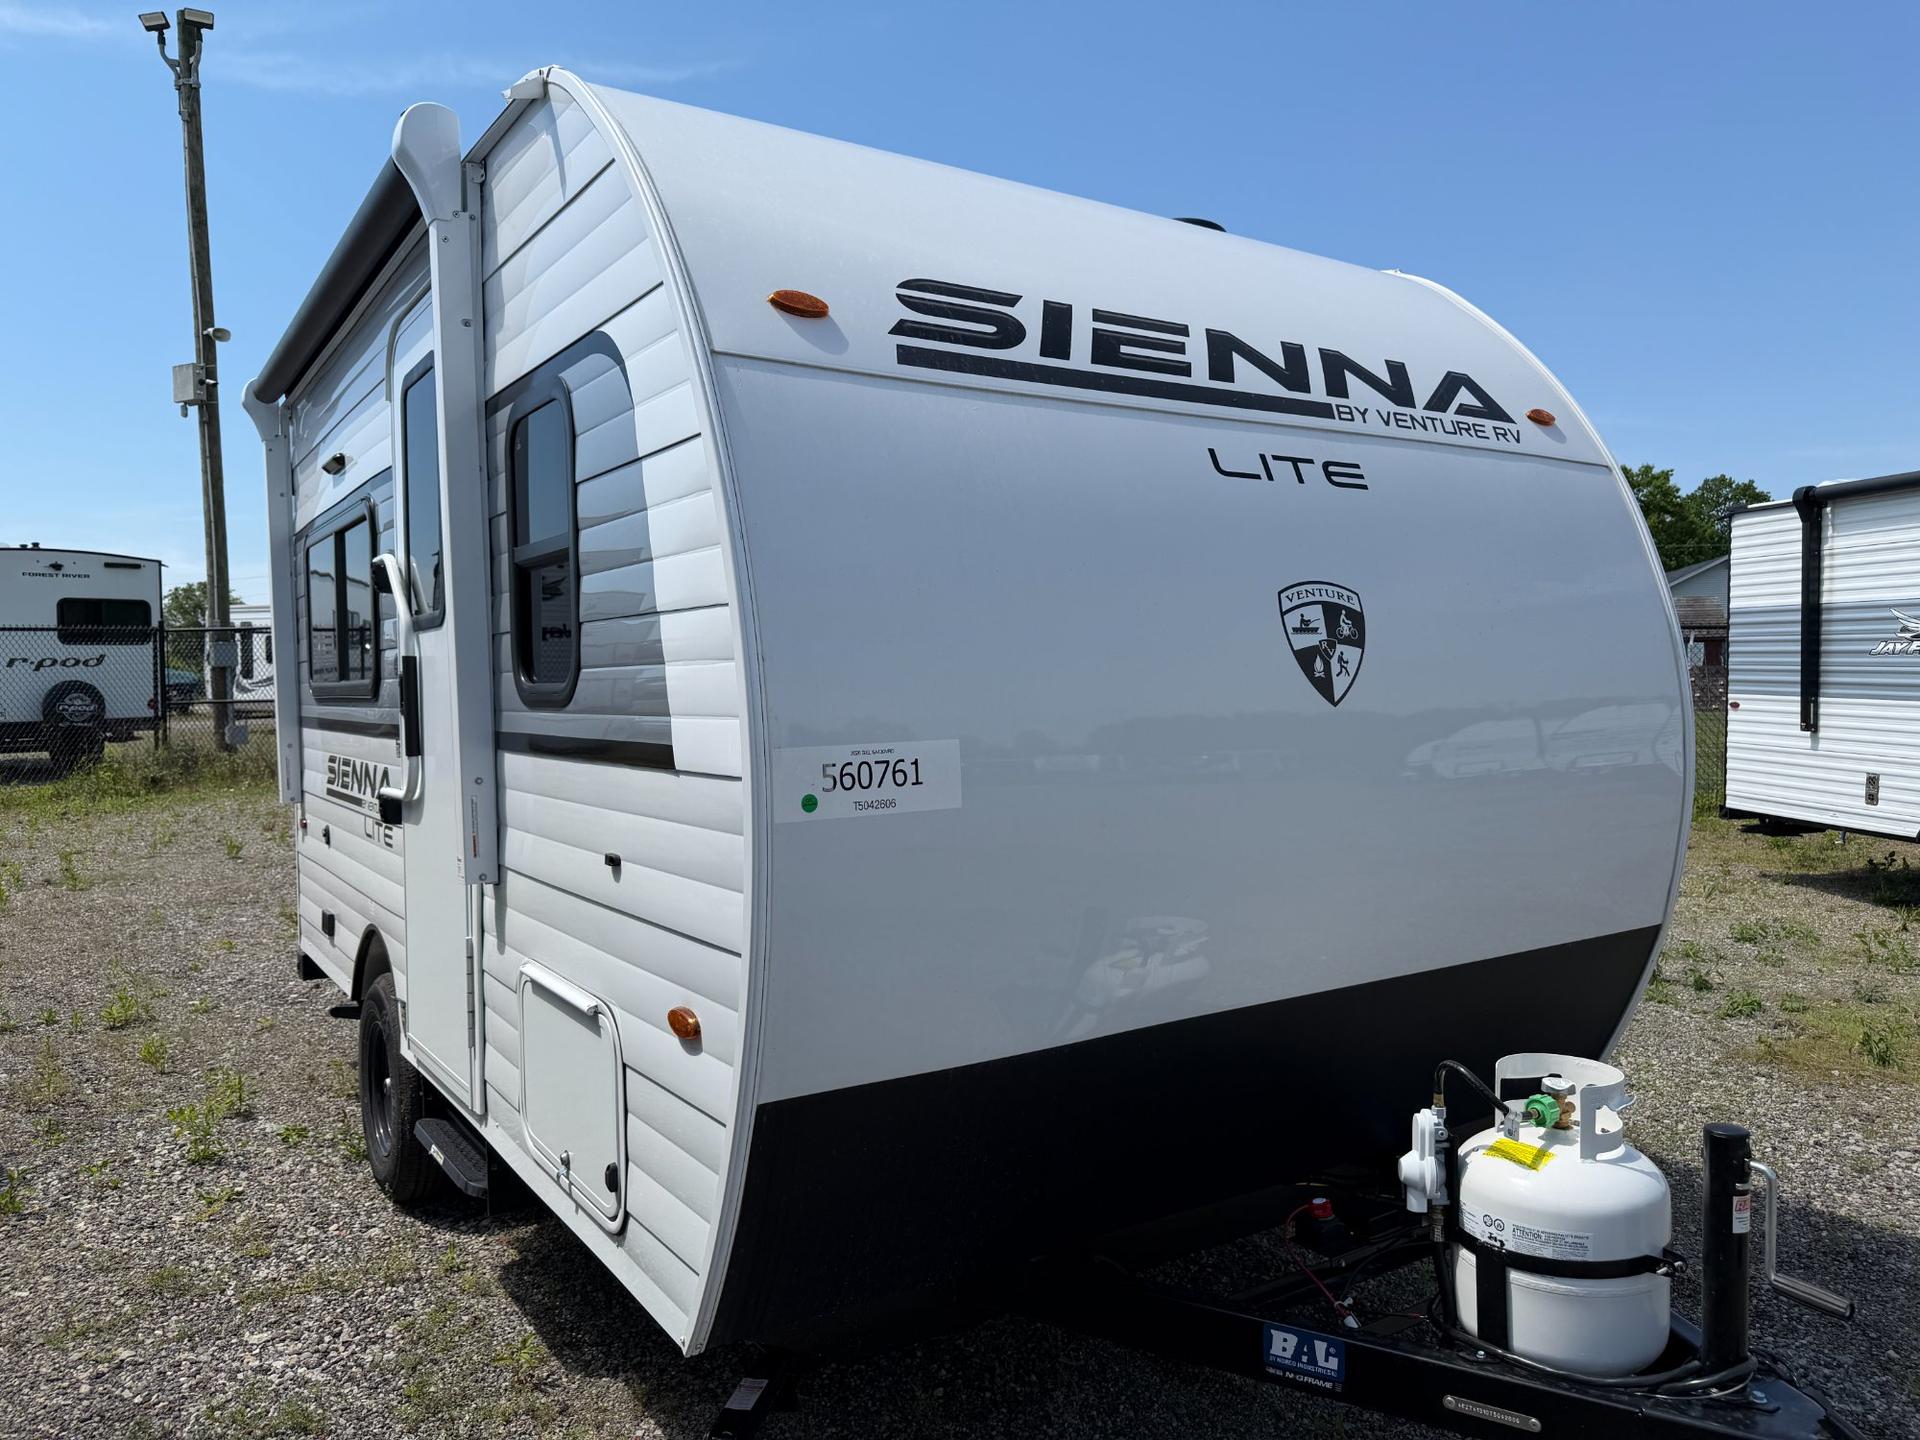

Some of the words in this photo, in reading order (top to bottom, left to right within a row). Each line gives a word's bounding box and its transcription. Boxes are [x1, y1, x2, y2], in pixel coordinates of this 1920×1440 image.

[887, 278, 1516, 425] SIENNA
[1335, 404, 1369, 424] BY
[1376, 408, 1490, 440] VENTURE
[1495, 427, 1521, 444] RV
[1207, 447, 1369, 491] LITE
[22, 571, 59, 579] FOREST
[1285, 587, 1356, 606] VENTURE
[1869, 640, 1911, 655] JAY
[327, 755, 391, 800] SIENNA
[822, 758, 924, 792] 560761
[853, 798, 897, 811] T5042606
[364, 815, 393, 849] LITE
